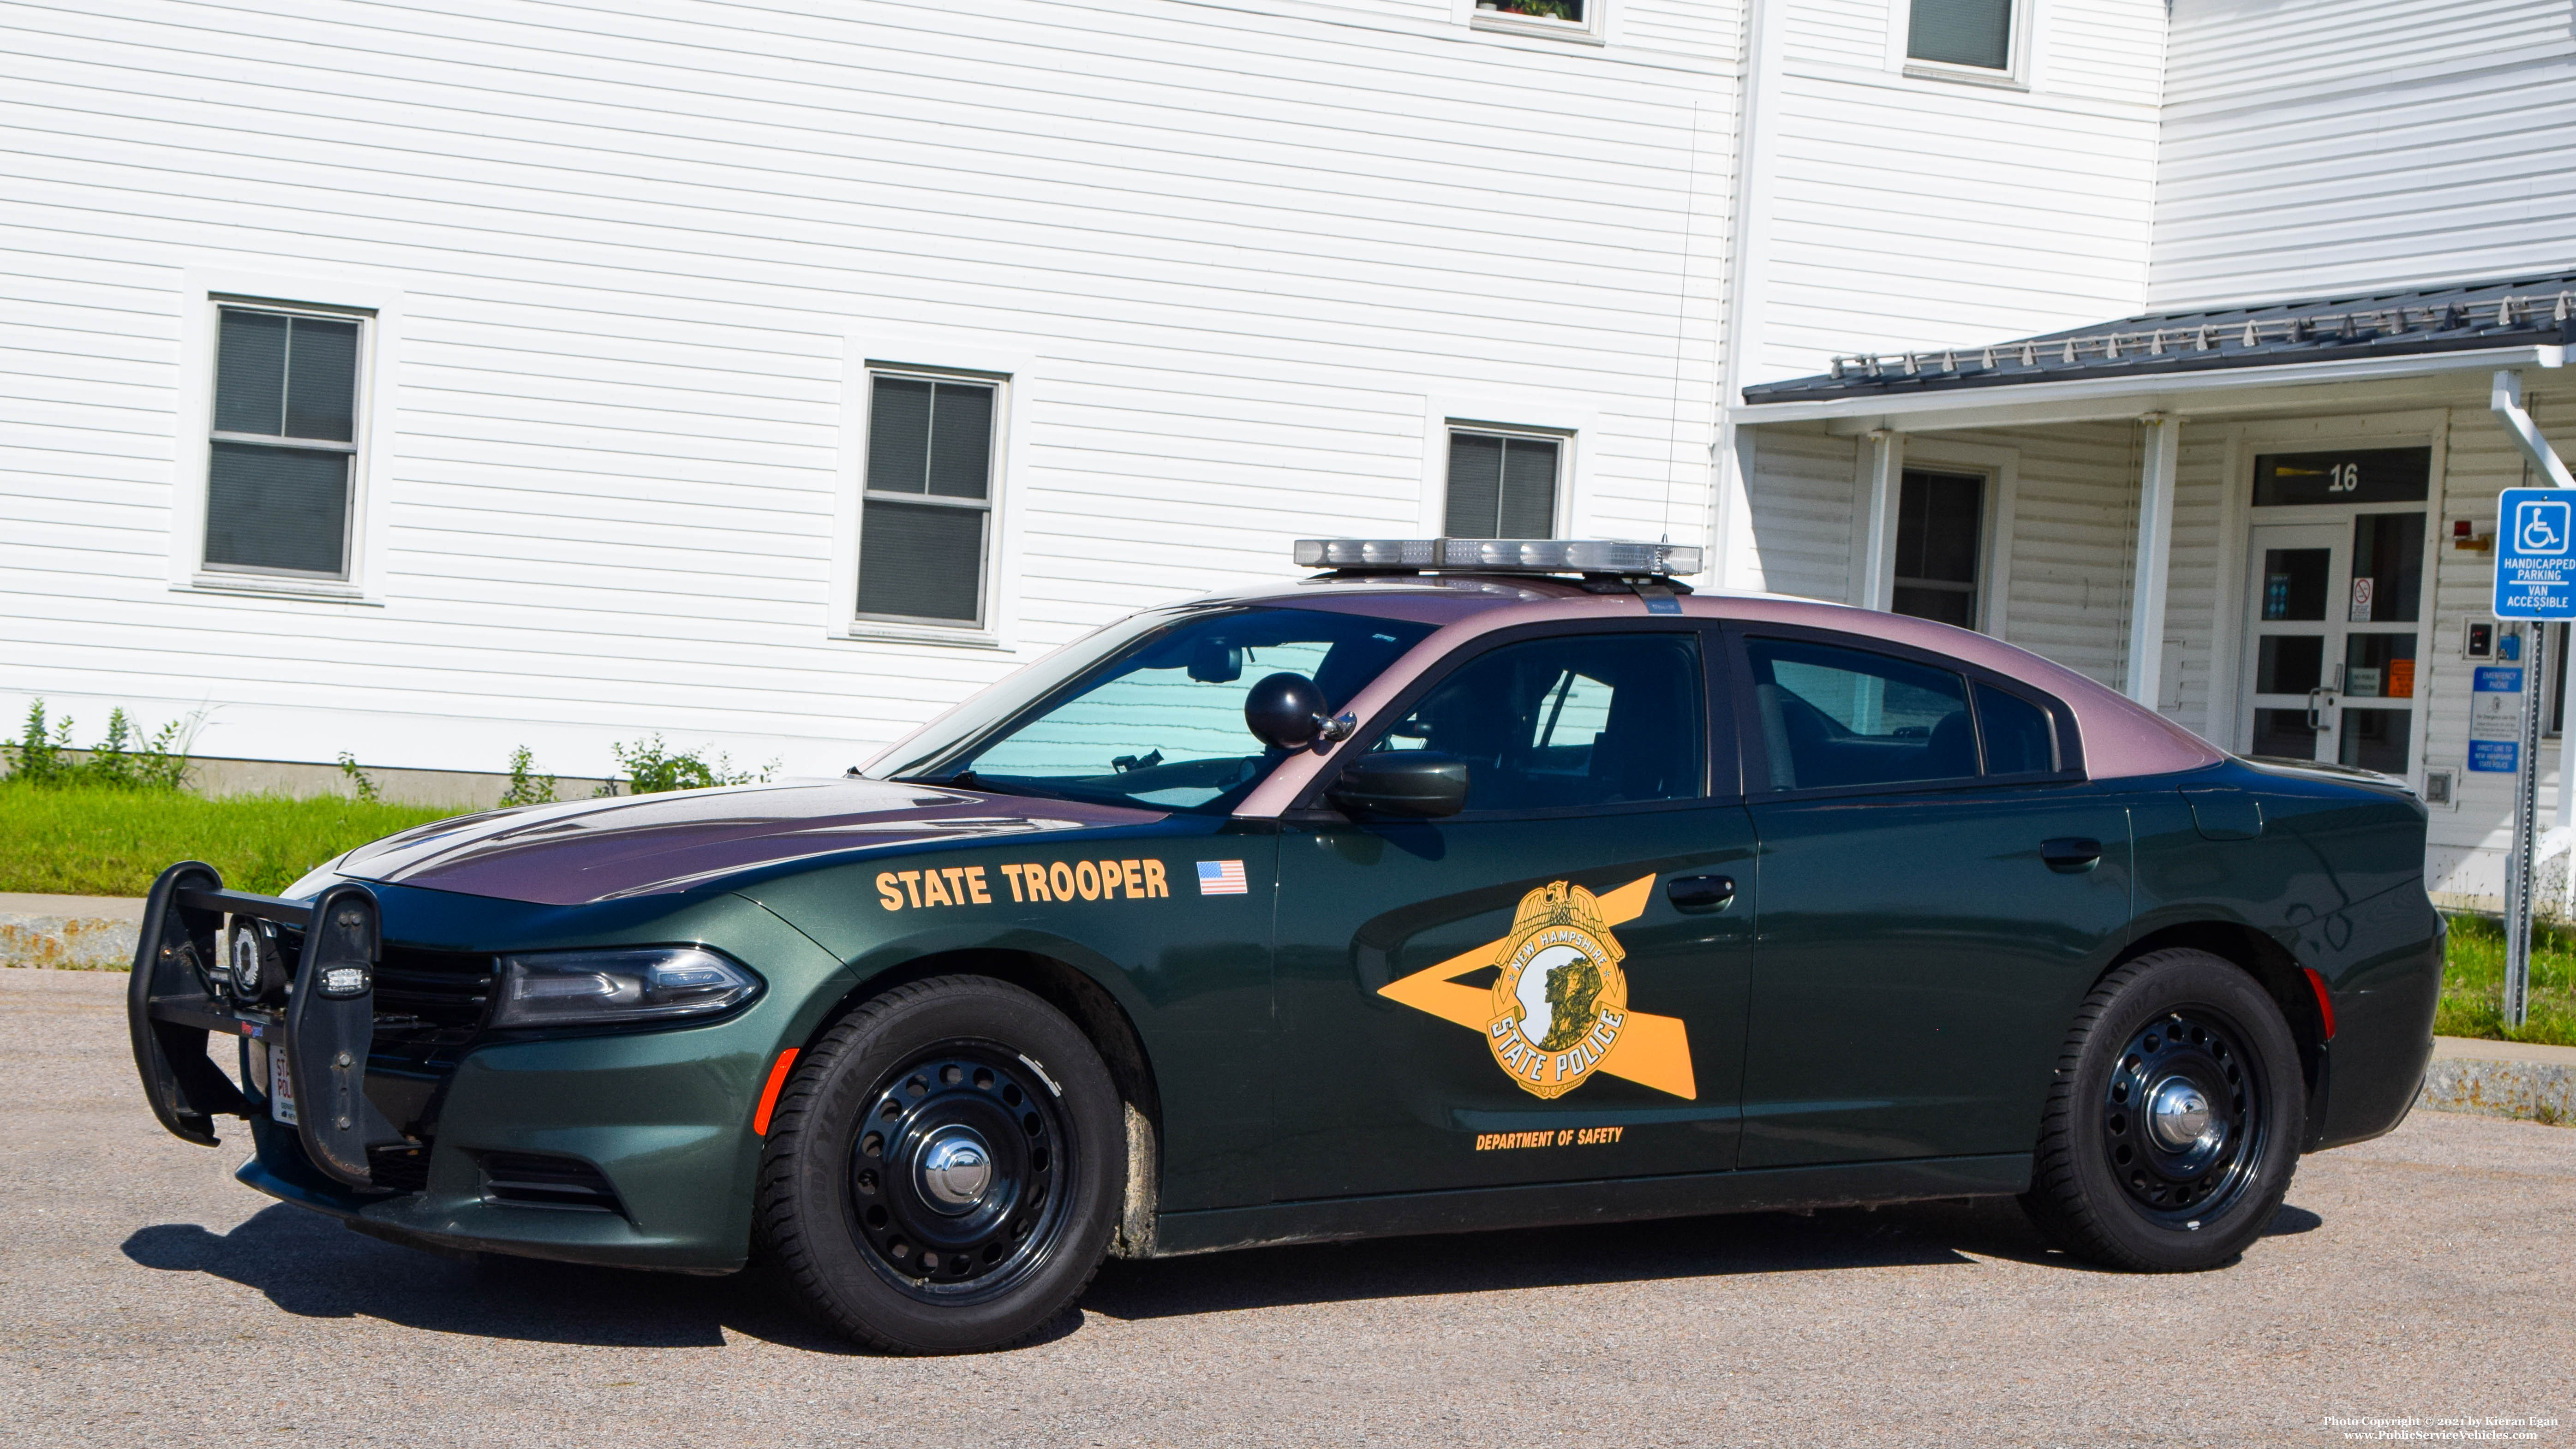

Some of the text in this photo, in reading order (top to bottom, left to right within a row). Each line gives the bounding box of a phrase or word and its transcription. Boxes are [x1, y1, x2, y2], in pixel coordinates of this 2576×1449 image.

[2329, 463, 2358, 491] 16
[2504, 558, 2576, 570] HANDICAPPED
[2517, 570, 2561, 580] PARKING
[2528, 585, 2548, 596] VAN
[2507, 596, 2569, 608] ACCESSIBLE
[2483, 671, 2517, 680] EMERGENCY
[876, 859, 1169, 911] STATE TROOPER
[1511, 930, 1607, 971] NEW HAMPSHIRE
[1492, 1008, 1625, 1081] STATE POLICE
[1476, 1127, 1624, 1151] DEPARTMENT OF SAFETY
